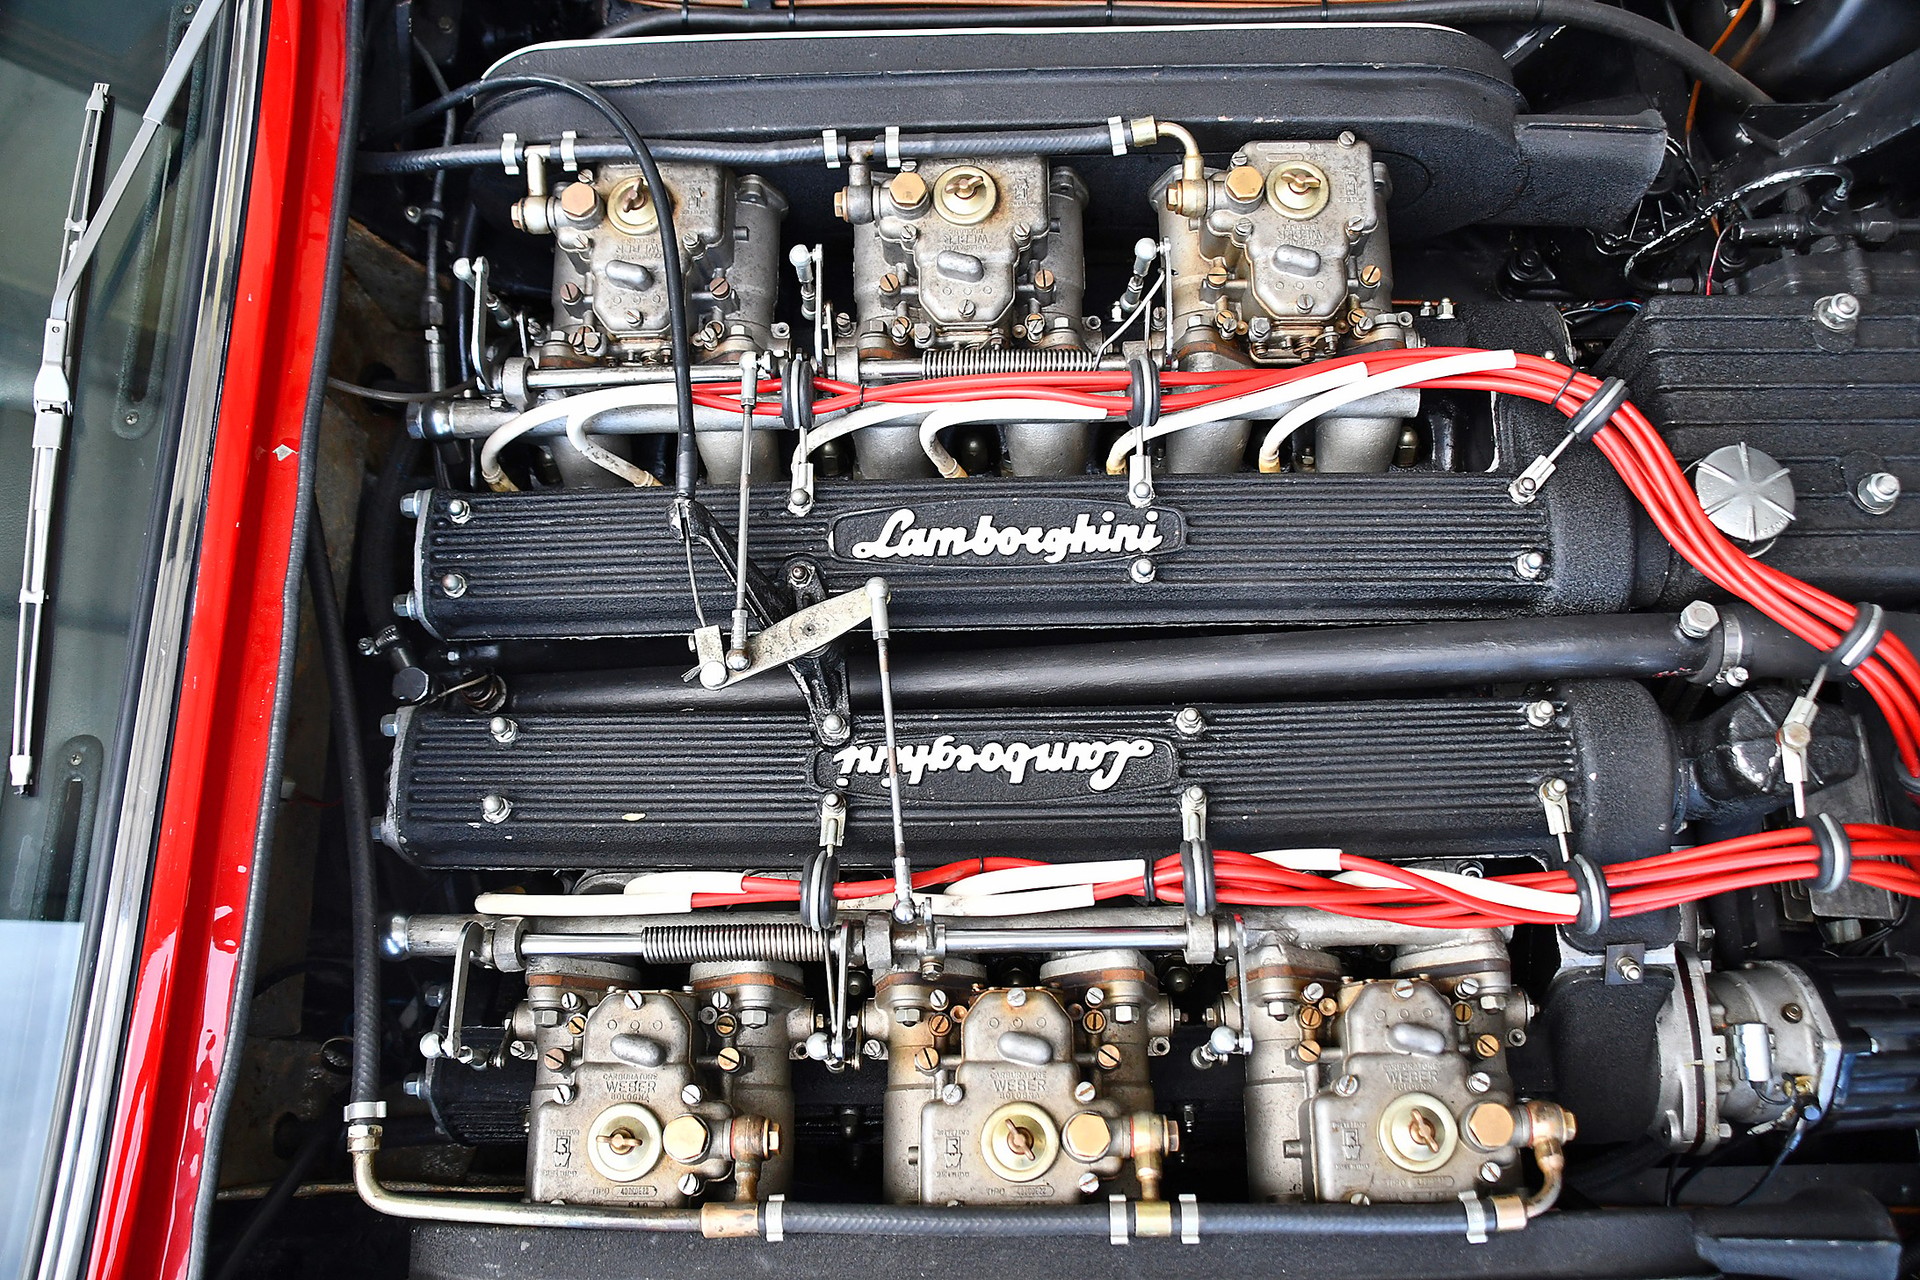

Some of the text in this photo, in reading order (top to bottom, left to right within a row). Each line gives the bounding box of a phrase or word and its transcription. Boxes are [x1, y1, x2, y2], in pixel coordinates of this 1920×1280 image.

[943, 234, 989, 244] WEBER
[852, 508, 1164, 564] Lamborghini
[1386, 1070, 1439, 1083] WEBER
[606, 1080, 657, 1093] WEBER
[993, 1079, 1047, 1092] WEBER
[610, 1093, 650, 1101] BOLOGNA
[999, 1092, 1040, 1100] BOLOGNA
